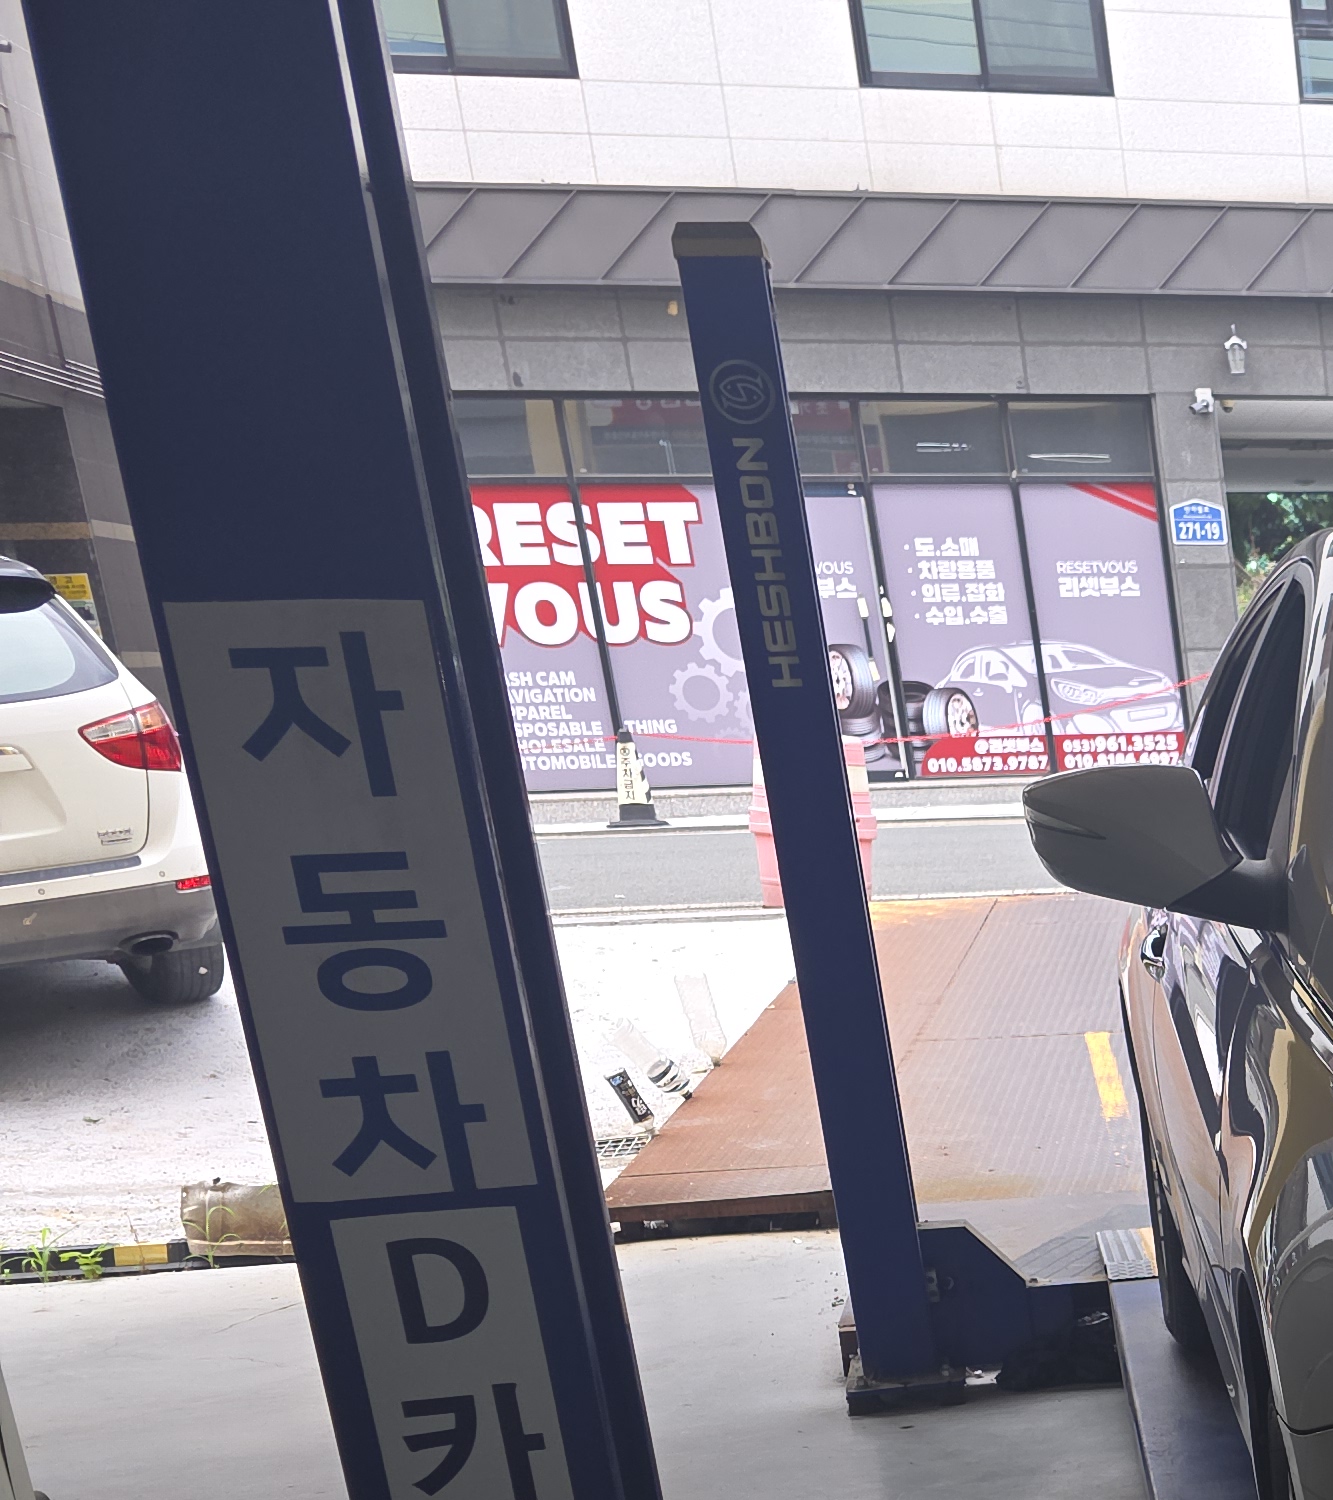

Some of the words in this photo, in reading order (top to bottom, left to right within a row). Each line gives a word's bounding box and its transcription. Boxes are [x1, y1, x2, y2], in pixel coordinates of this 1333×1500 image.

[731, 437, 803, 688] HESHBON
[917, 559, 996, 580] 차량용품
[1056, 559, 1138, 574] RESETVOUS
[1057, 575, 1141, 598] 리셋부스
[535, 670, 577, 687] CAM
[623, 719, 678, 735] THING
[228, 630, 488, 1194] 자동차
